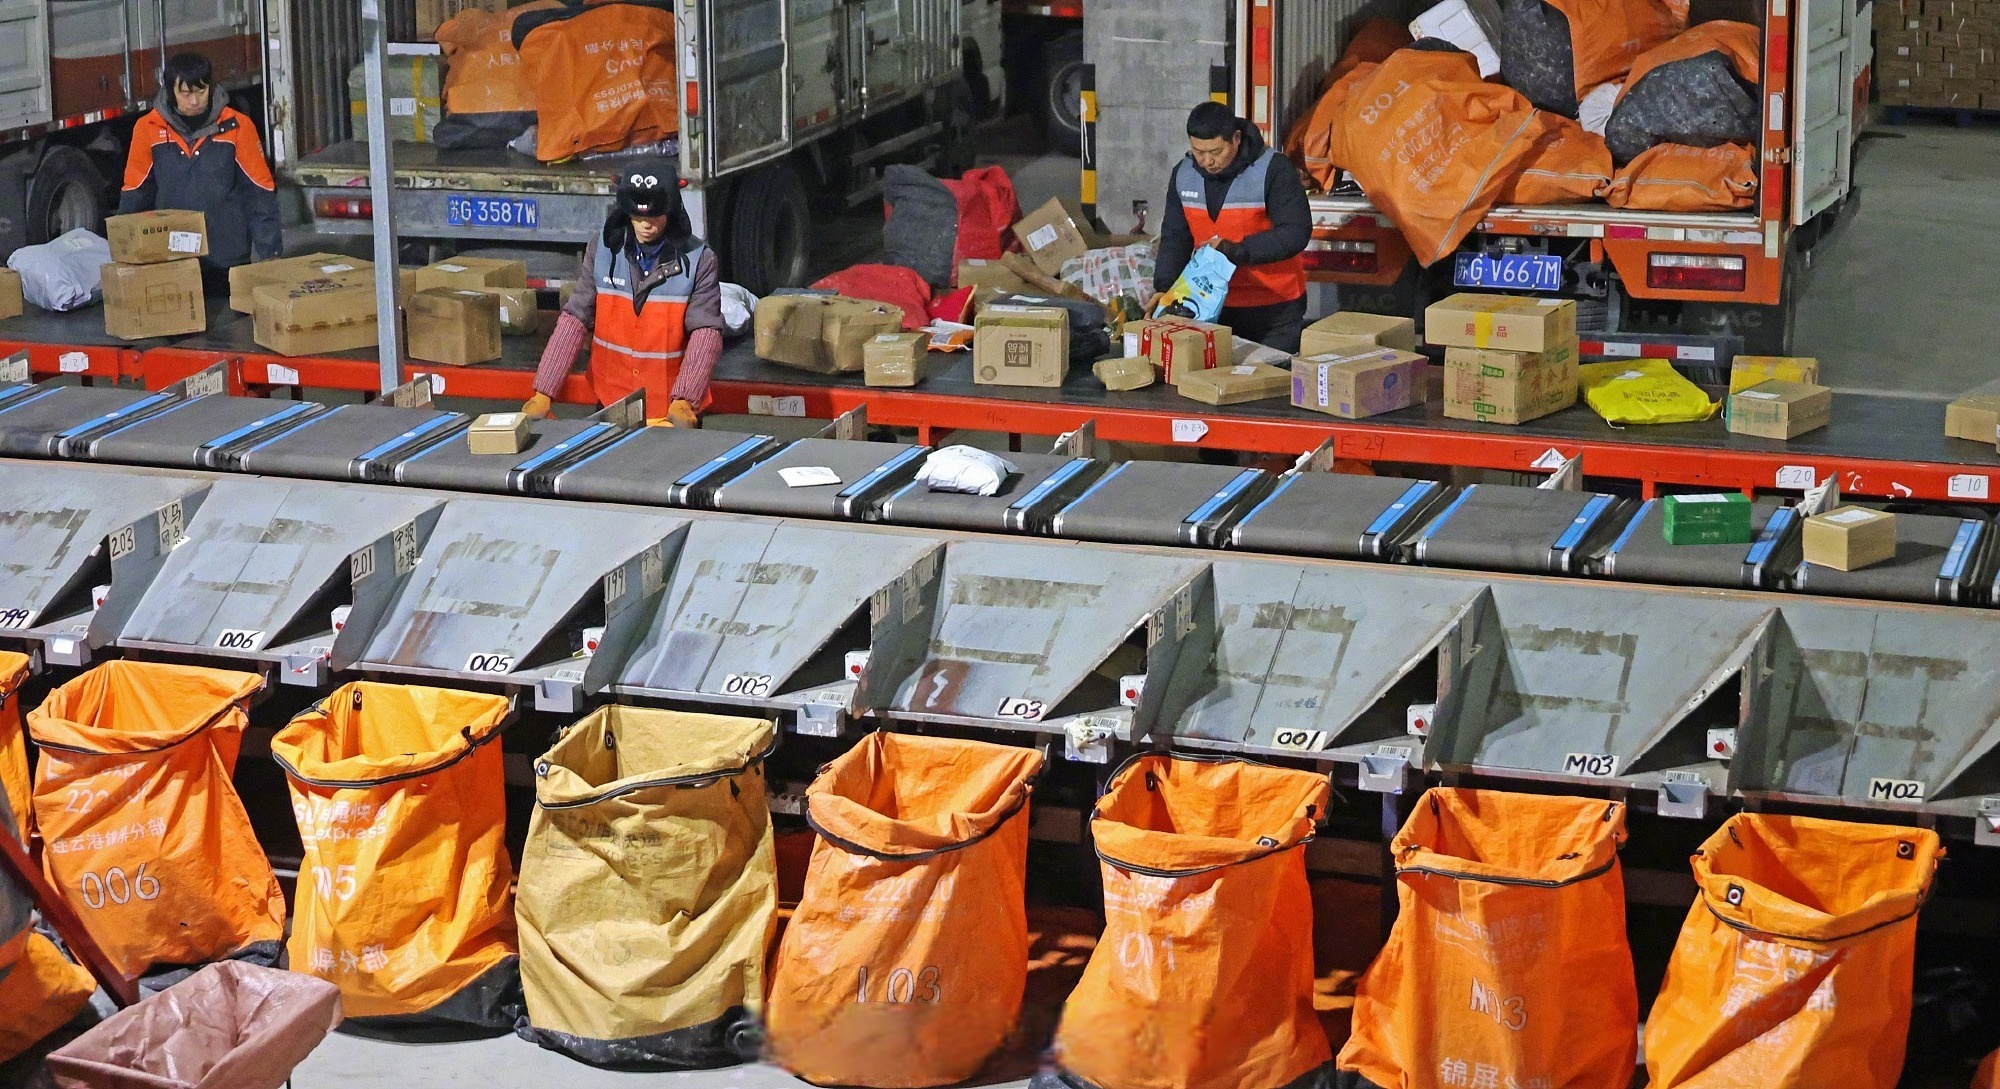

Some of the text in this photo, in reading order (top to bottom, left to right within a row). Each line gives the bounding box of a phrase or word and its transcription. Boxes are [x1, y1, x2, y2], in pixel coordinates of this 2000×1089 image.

[111, 527, 134, 558] 203
[353, 548, 372, 579] 201
[607, 570, 624, 602] 199
[219, 632, 262, 649] 006
[470, 654, 515, 673] 005
[726, 675, 771, 697] 003
[997, 696, 1042, 718] L03
[1277, 731, 1321, 751] 001
[1565, 755, 1614, 776] M03
[1872, 780, 1923, 800] M02
[314, 822, 389, 844] express
[81, 862, 161, 909] 006
